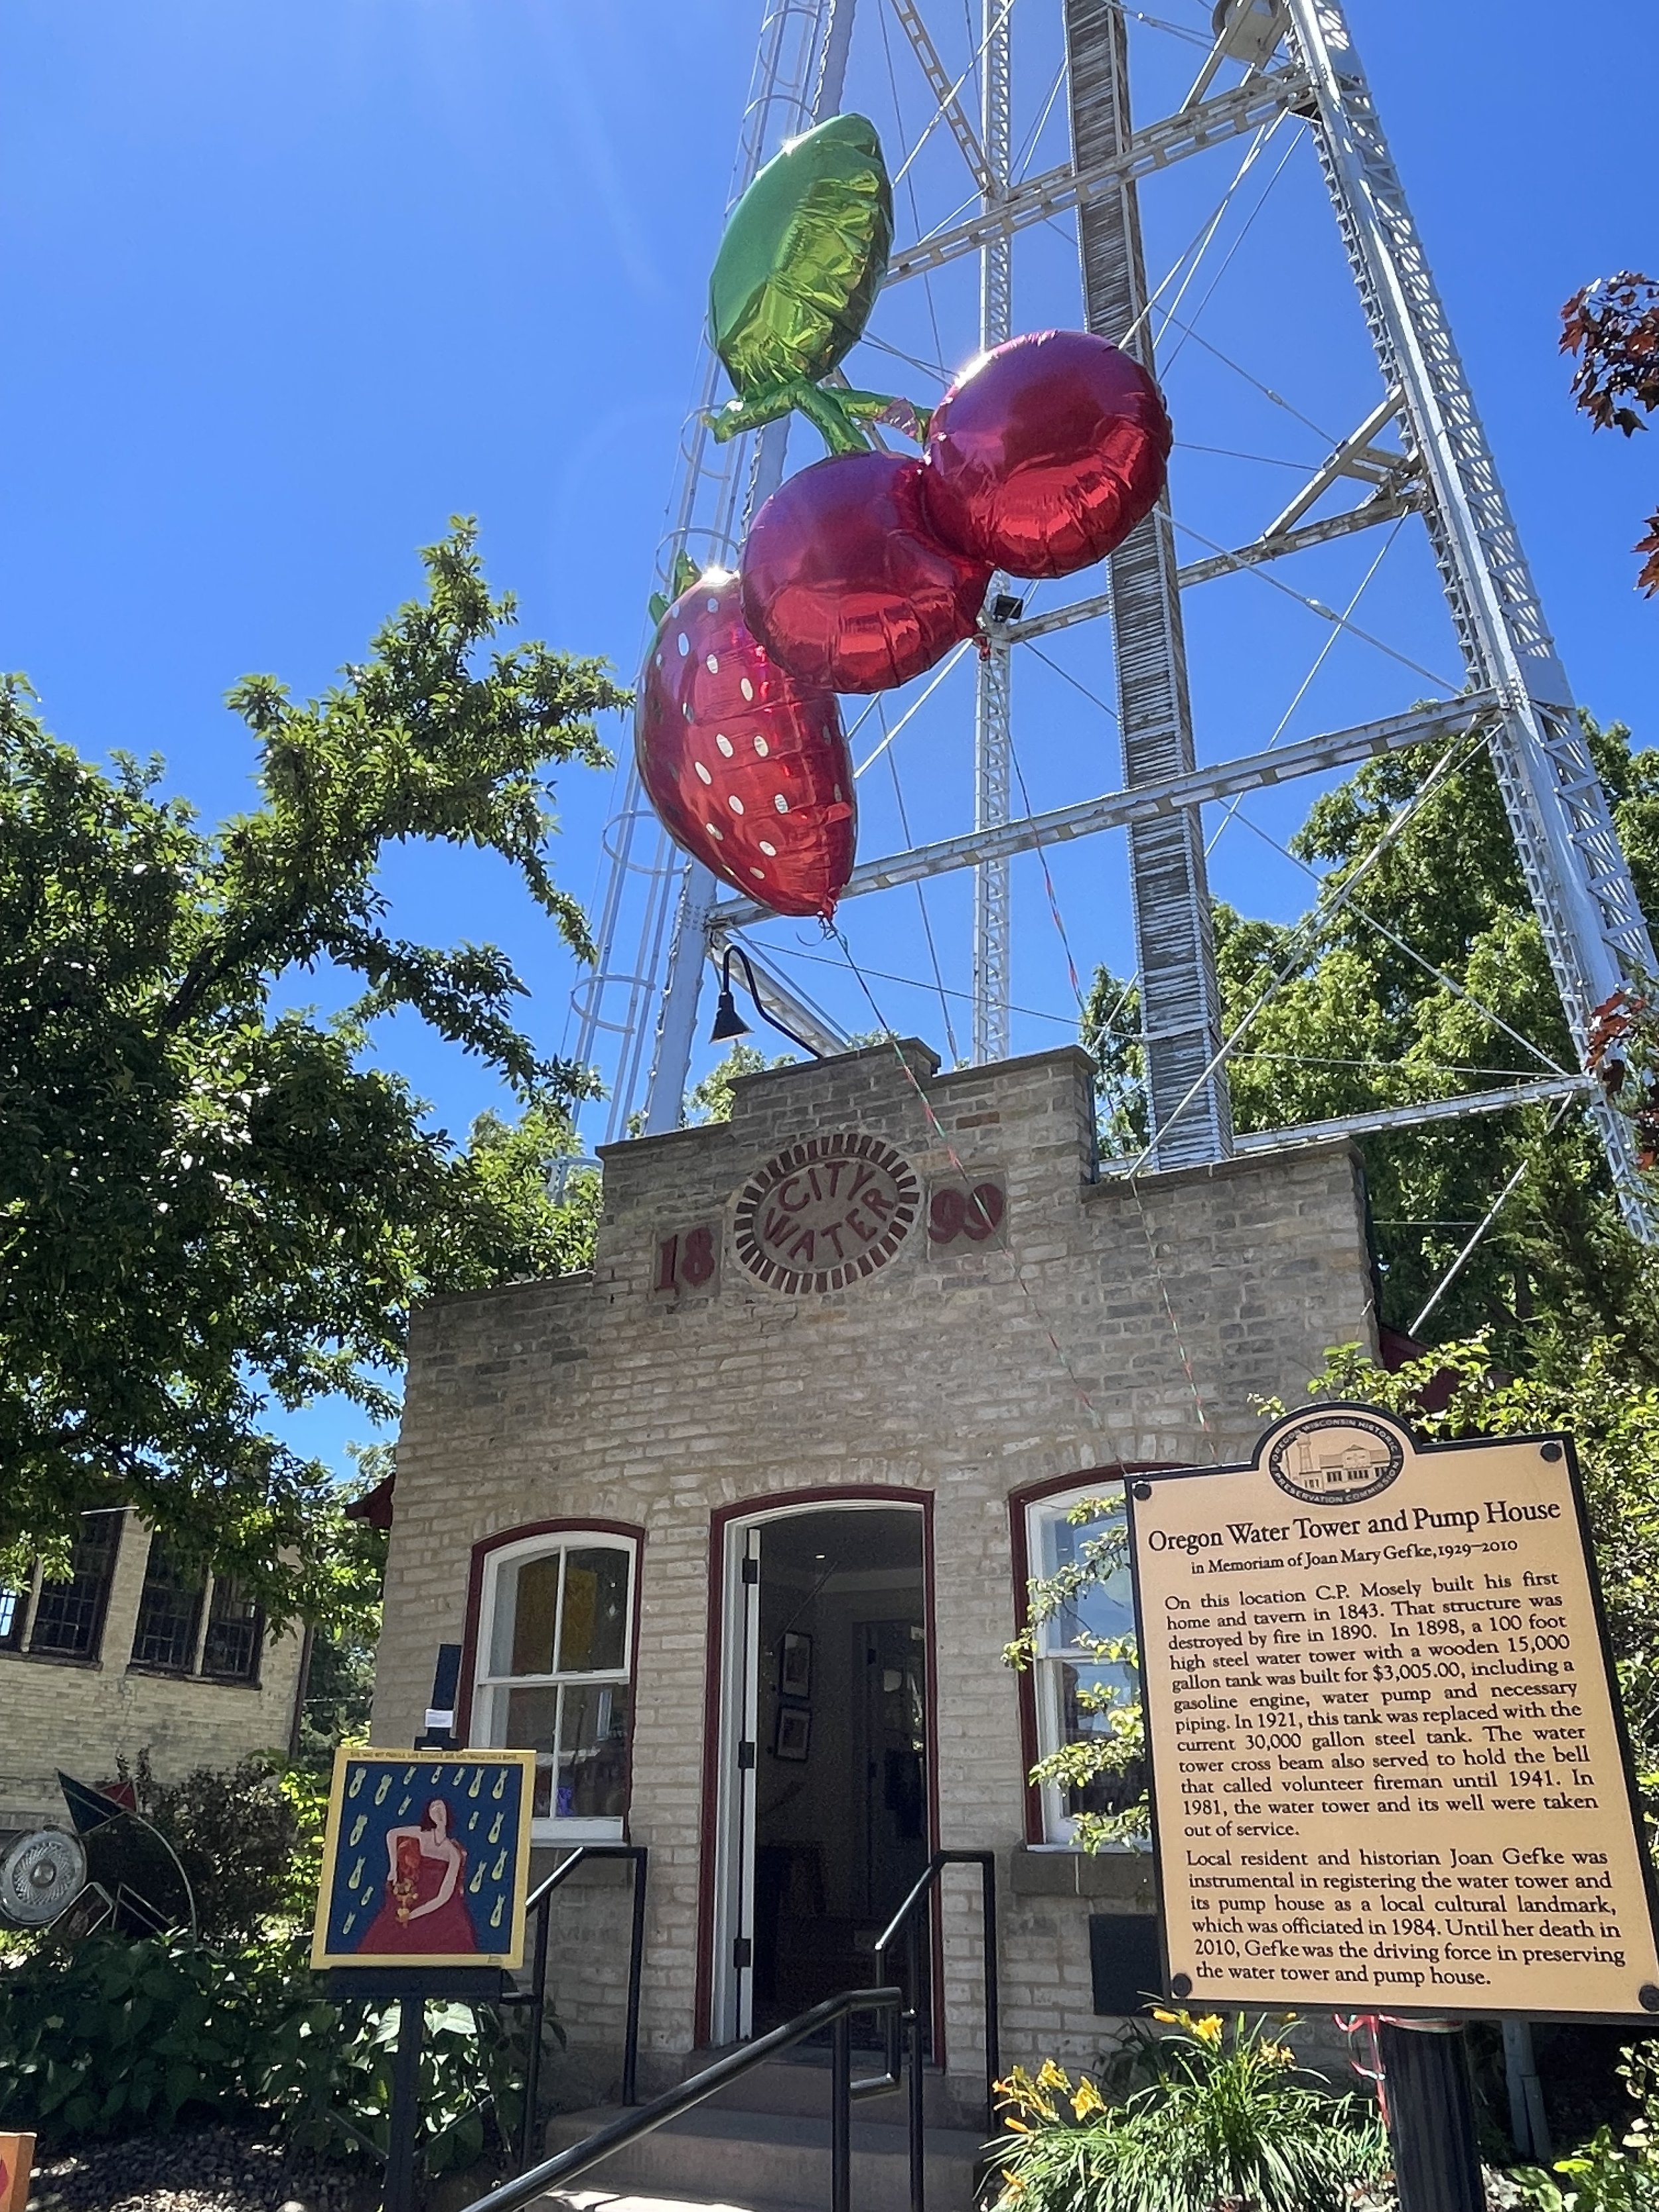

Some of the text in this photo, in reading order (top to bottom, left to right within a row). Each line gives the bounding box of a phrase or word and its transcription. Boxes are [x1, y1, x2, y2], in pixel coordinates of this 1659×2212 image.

[778, 1160, 876, 1213] CITY
[762, 1187, 896, 1262] WATER
[655, 1227, 715, 1293] 18
[1272, 1419, 1398, 1461] OREGON WISCONSIN HISTORIC
[1274, 1461, 1400, 1503] PRESERVATION COMMISSION
[1148, 1500, 1561, 1555] Oregon Water Tower and Pump House
[1190, 1562, 1205, 1575] in
[1207, 1556, 1284, 1573] Memoriam
[1287, 1552, 1304, 1570] of
[1301, 1552, 1338, 1570] Joan
[1340, 1548, 1381, 1565] Mary
[1164, 1570, 1559, 1610] On this location C.P. Mosely built his first
[1166, 1595, 1562, 1630] home and tavern in 1843. That structure was
[1168, 1613, 1567, 1651] destroyed by fire in 1890. In 1898, a 100 foot
[1169, 1633, 1569, 1672] high steel water tower with a wooden 15,000
[1172, 1657, 1575, 1694] gallon tank was built for $3,005.00, including a
[1174, 1681, 1577, 1714] gasoline engine, water pump and necessary
[1175, 1700, 1582, 1734] piping. In 1921, this tank was replaced with the
[1177, 1725, 1585, 1751] current 30,000 gallon steel tank. The water
[1179, 1744, 1590, 1773] tower cross beam also served to hold the bell
[1181, 1768, 1594, 1793] that called volunteer fireman until 1941. In
[1183, 1791, 1599, 1816] 1981, the water tower and its well were taken
[1184, 1820, 1299, 1836] out of service.
[1186, 1846, 1608, 1868] Local resident and historian Joan Gefke was
[1189, 1870, 1613, 1892] instrumental in registering the water tower and
[1190, 1893, 1616, 1915] its pump house as a local cultural landmark,
[1192, 1915, 1621, 1937] which was officiated in 1984. Until her death in
[1194, 1938, 1625, 1967] 2010, Gefke was the driving force in preserving
[1196, 1960, 1490, 1988] the water tower and pump house.
